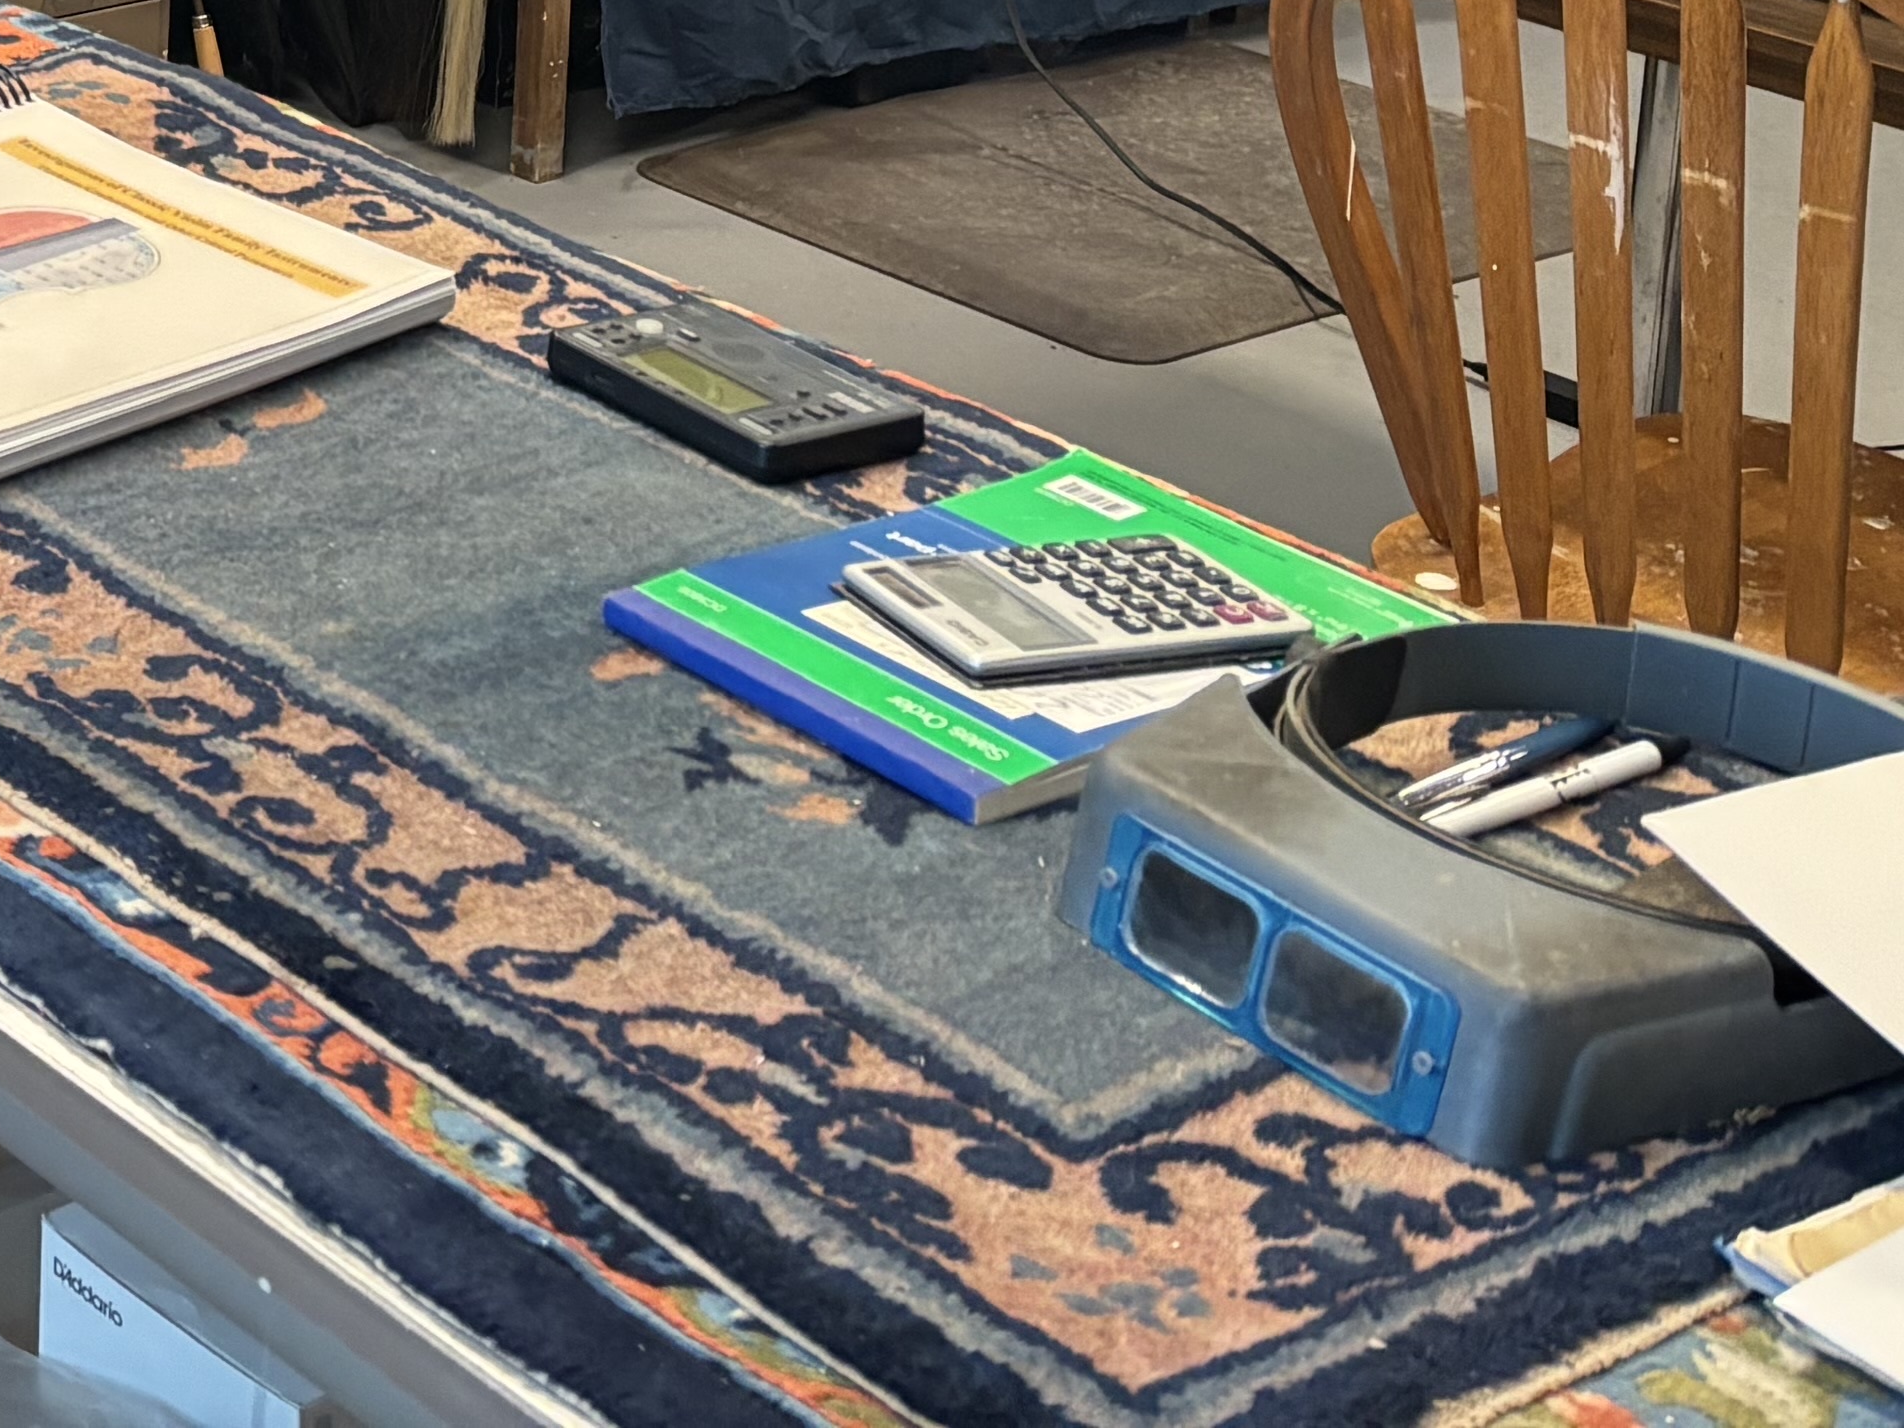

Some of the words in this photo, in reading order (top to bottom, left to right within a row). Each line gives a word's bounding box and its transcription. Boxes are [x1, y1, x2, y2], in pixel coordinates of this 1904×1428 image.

[886, 693, 949, 730] Order
[948, 725, 1010, 761] Sales
[53, 1255, 123, 1327] D'Addario
